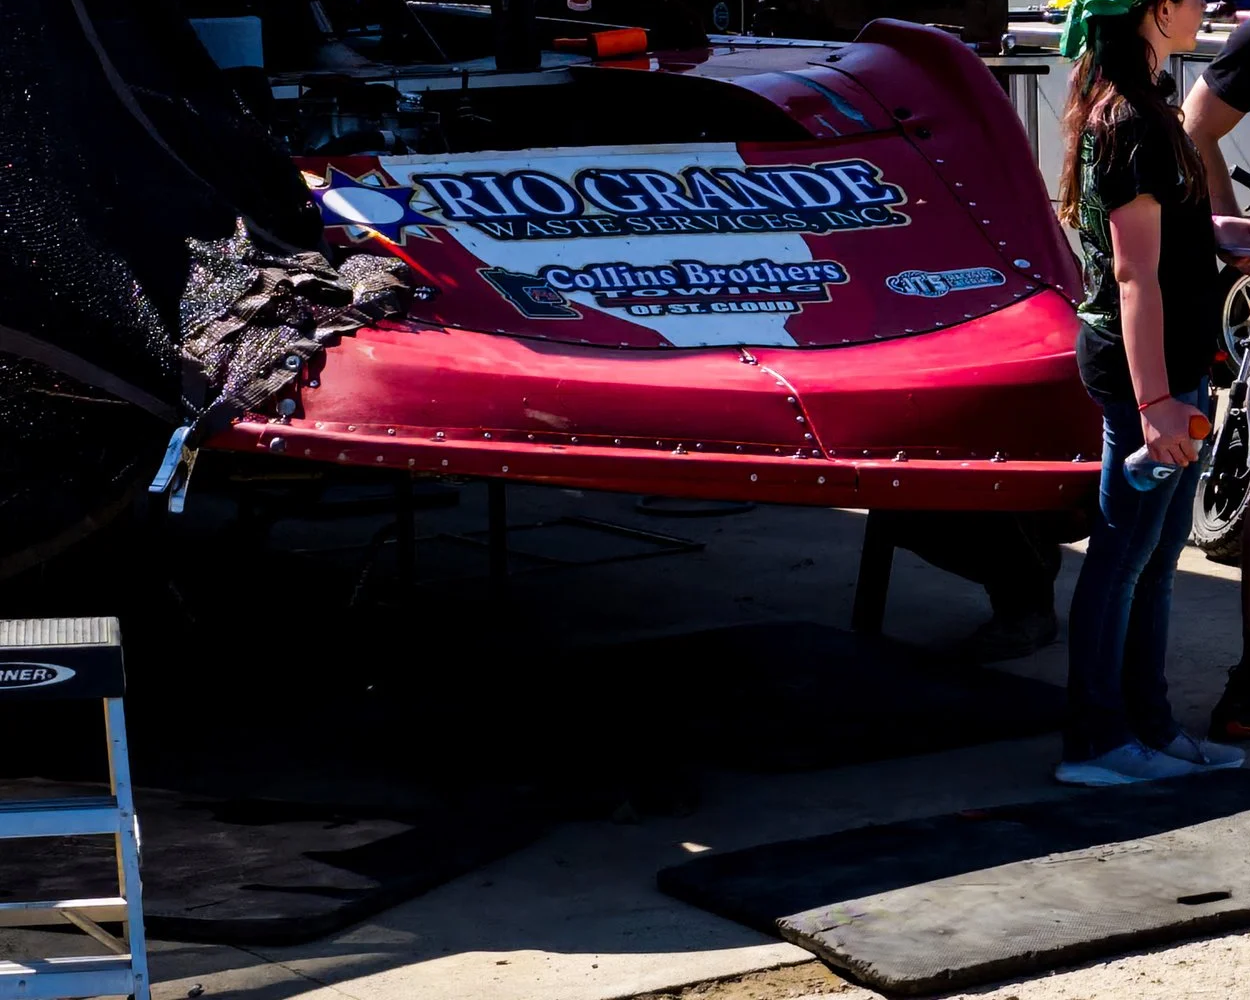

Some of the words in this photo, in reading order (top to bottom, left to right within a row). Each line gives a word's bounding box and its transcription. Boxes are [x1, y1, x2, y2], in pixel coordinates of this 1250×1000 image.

[422, 174, 576, 218] RIO
[584, 164, 894, 214] GRANDE
[480, 218, 621, 237] WASTE
[822, 207, 898, 226] INC.
[546, 266, 676, 290] Collins
[680, 262, 842, 285] Brothers
[600, 285, 821, 298] TOWING
[631, 304, 662, 315] OF
[668, 303, 707, 313] ST.
[710, 301, 795, 313] CLOUD
[0, 669, 48, 682] NER
